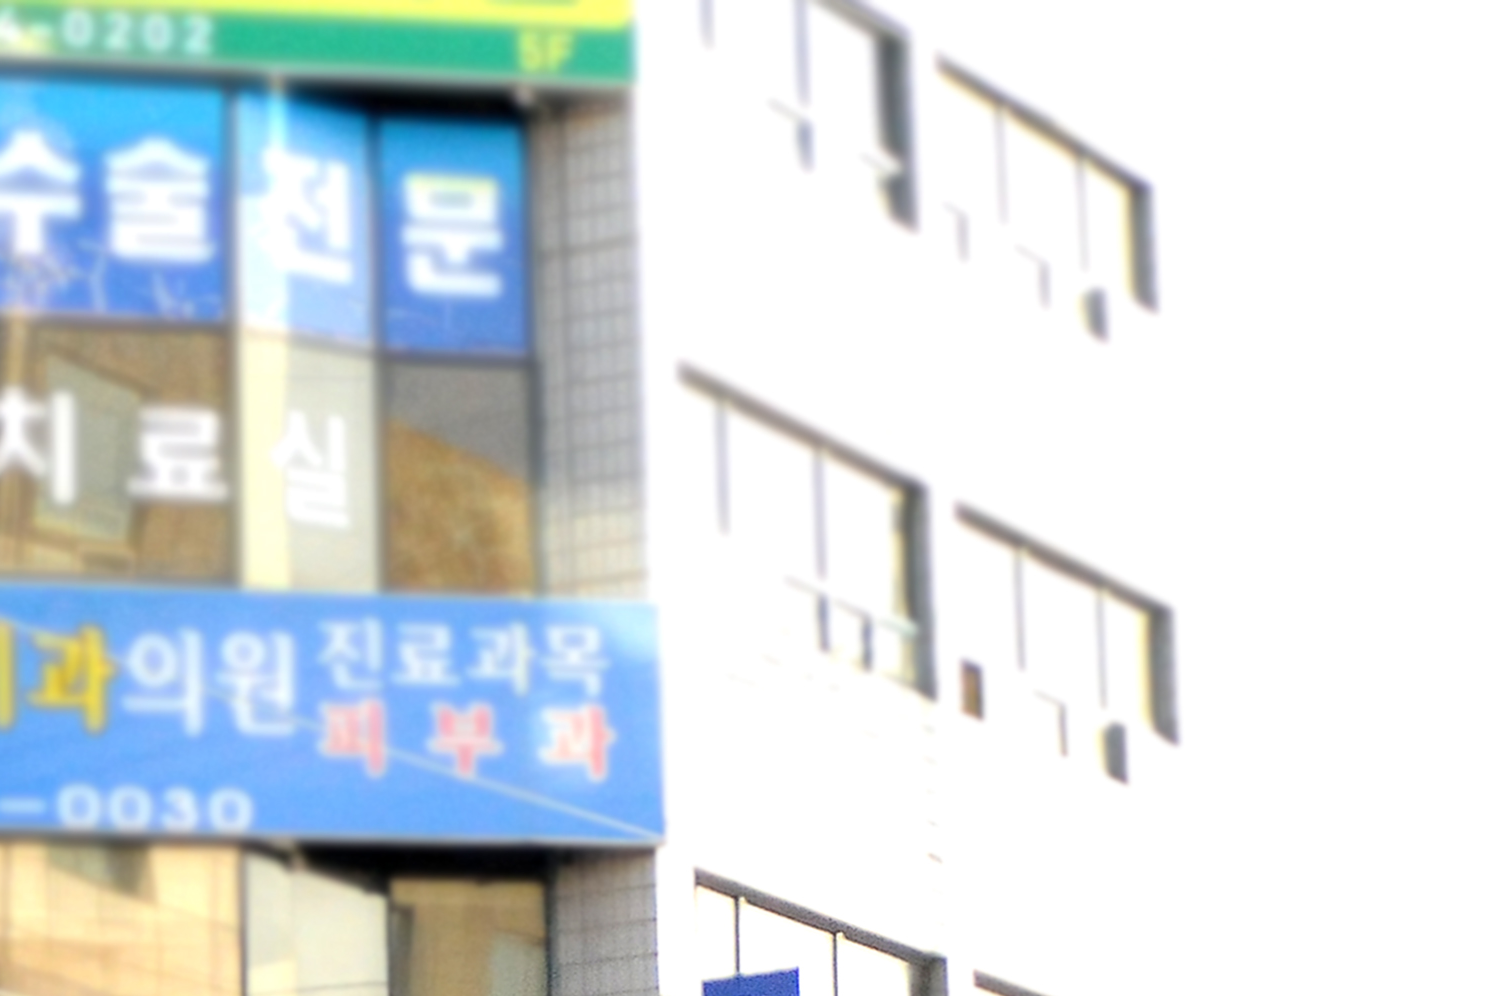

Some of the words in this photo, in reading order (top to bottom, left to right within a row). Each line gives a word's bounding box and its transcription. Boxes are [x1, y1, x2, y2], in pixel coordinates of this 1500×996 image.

[516, 31, 576, 72] 5F
[316, 618, 610, 698] 진료과목
[317, 700, 615, 780] 피부과
